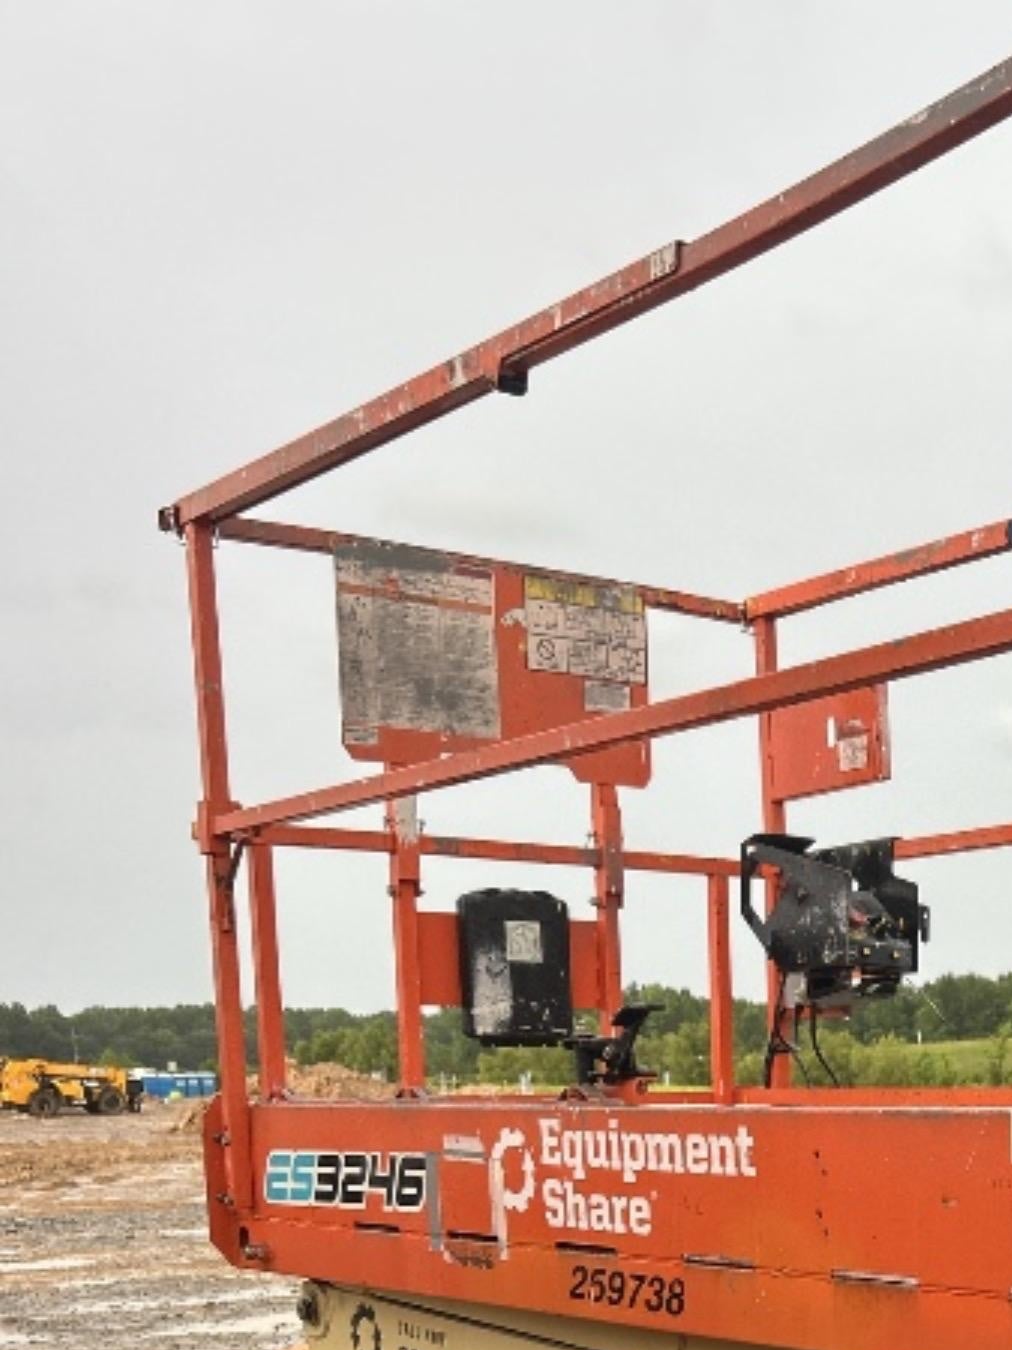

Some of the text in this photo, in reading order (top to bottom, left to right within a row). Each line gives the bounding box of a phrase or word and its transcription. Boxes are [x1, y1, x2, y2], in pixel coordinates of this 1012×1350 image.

[264, 1149, 430, 1212] ES3246
[538, 1117, 757, 1183] Equipment
[541, 1177, 653, 1236] Share
[568, 1265, 686, 1315] 259738
